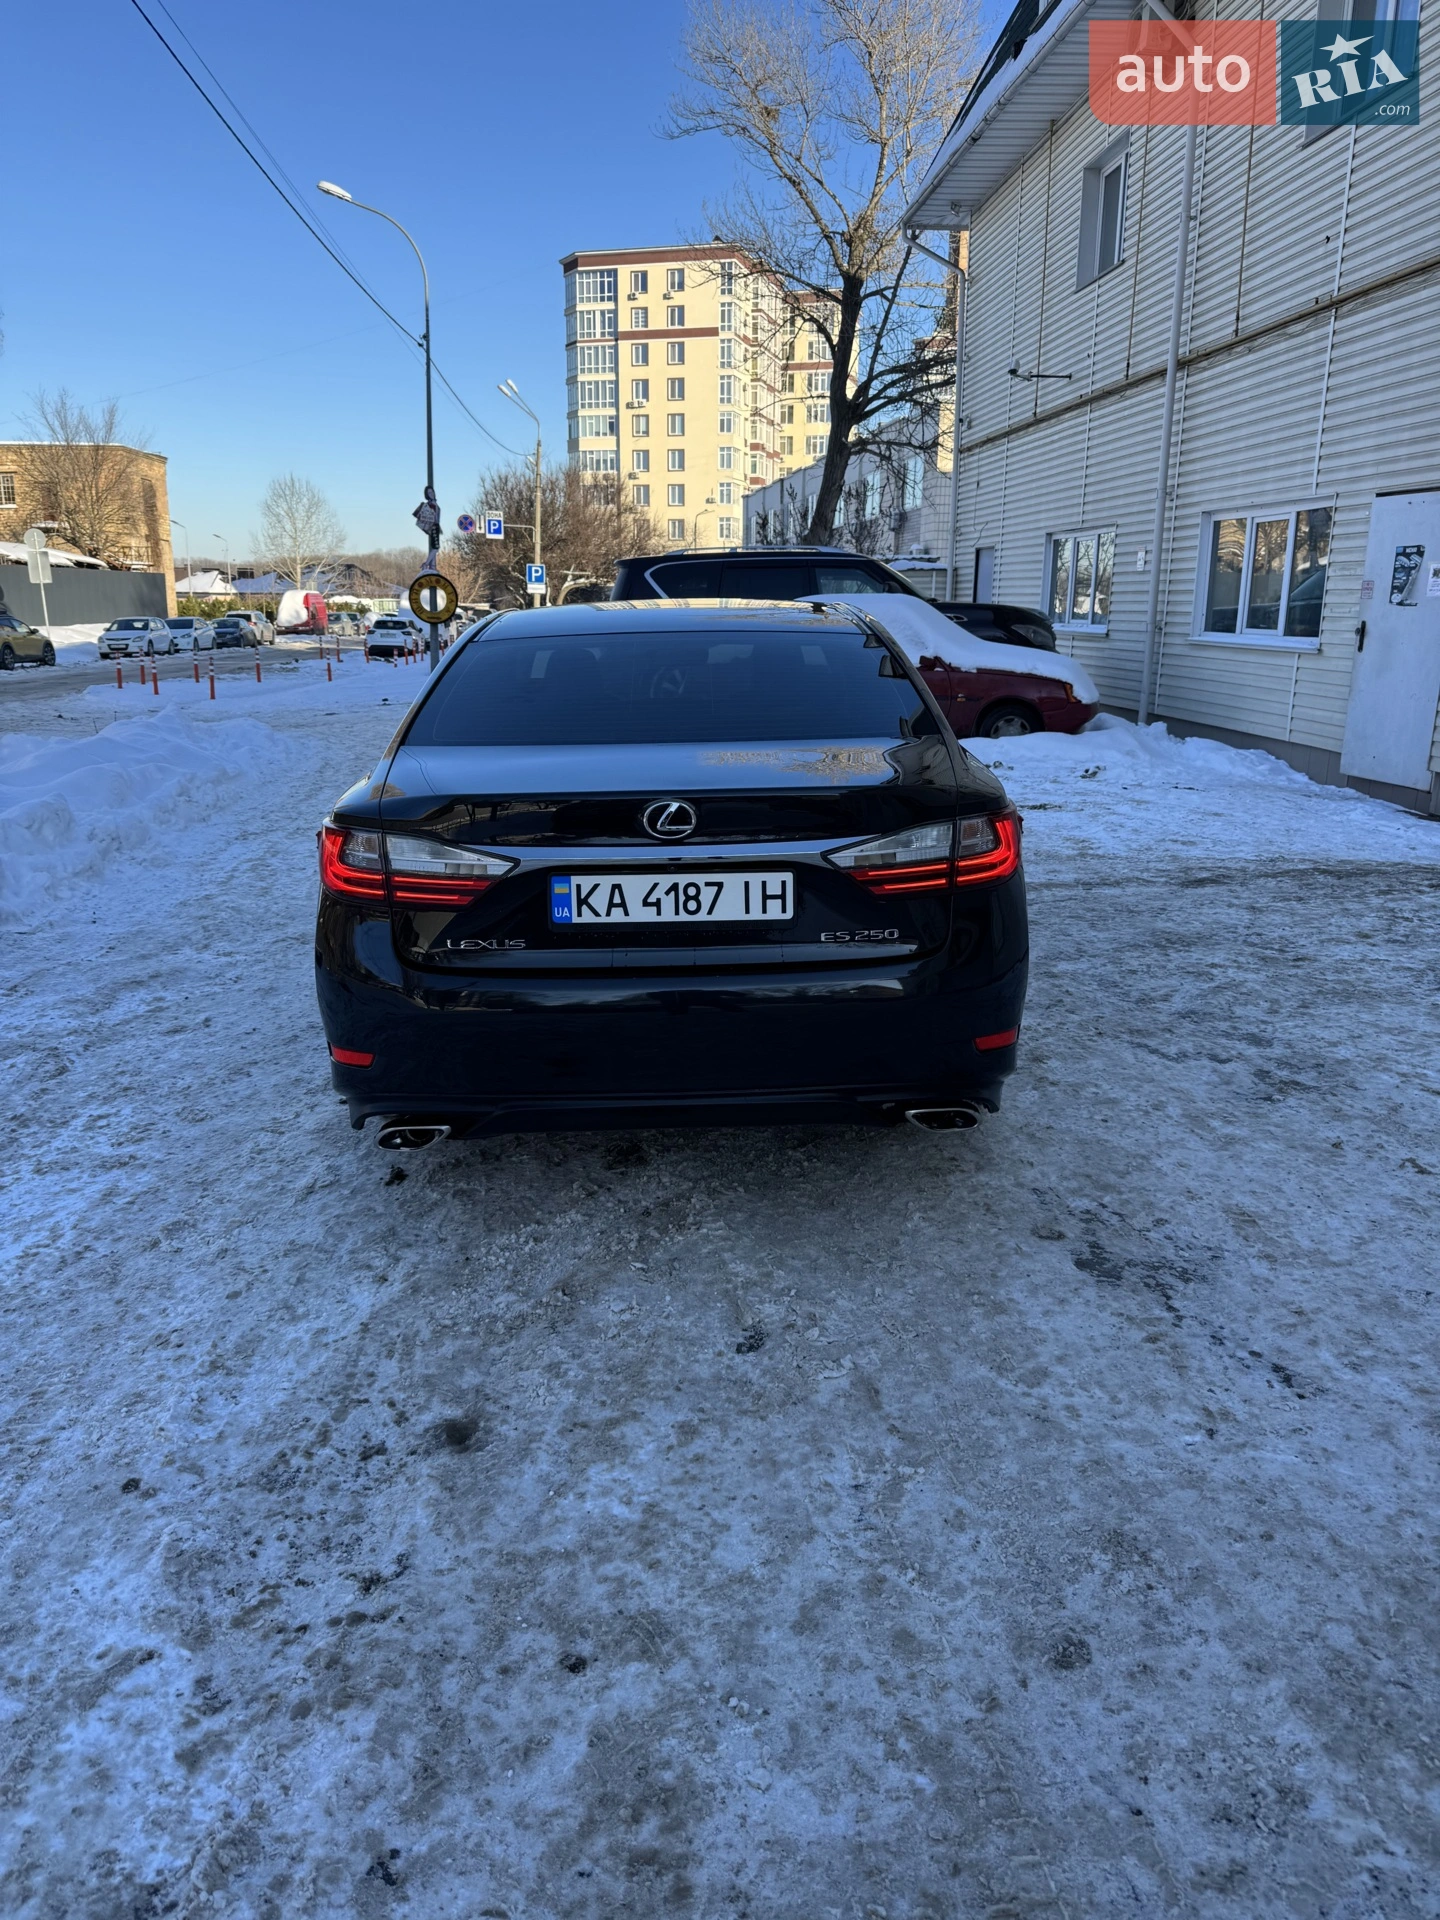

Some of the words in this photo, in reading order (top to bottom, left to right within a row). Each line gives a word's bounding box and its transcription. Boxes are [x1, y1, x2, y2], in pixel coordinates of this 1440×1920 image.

[531, 566, 542, 582] P
[575, 883, 630, 917] KA
[642, 881, 724, 916] 4187
[744, 880, 787, 915] IH
[554, 907, 570, 917] UA
[820, 931, 851, 941] ES
[854, 928, 900, 940] 250
[446, 939, 526, 949] LEXUS
